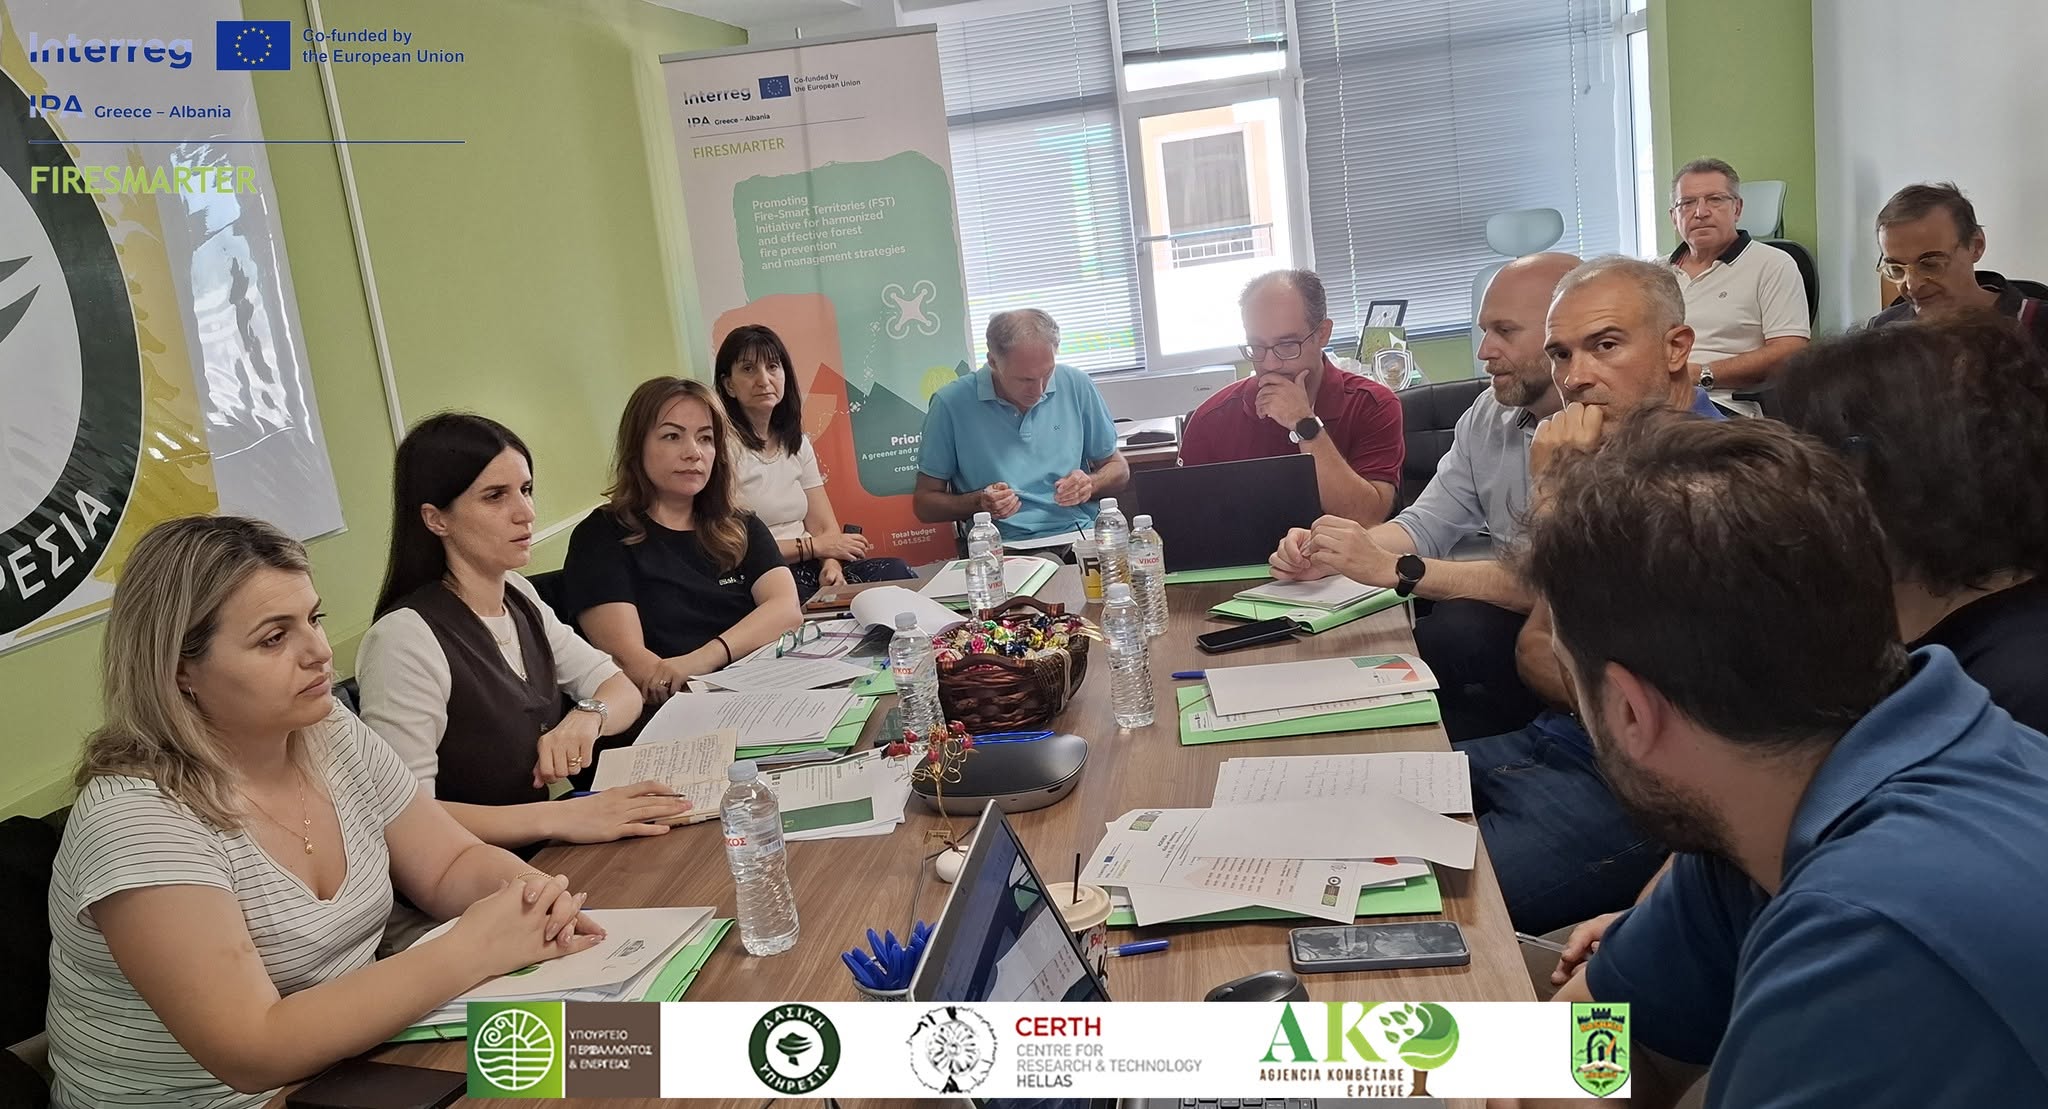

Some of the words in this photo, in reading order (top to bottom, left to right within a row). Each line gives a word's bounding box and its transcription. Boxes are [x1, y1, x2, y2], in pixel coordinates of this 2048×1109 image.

[794, 74, 828, 84] Co-funded
[829, 73, 839, 81] by
[795, 85, 806, 93] the
[807, 83, 840, 92] European
[841, 79, 861, 87] Union
[684, 87, 752, 105] Interreg
[687, 116, 710, 128] IPA
[714, 118, 739, 126] Greece
[745, 113, 771, 122] Albania
[693, 137, 785, 159] FIRESMARTER
[752, 195, 808, 210] Promoting
[754, 207, 810, 222] Fire-Smart
[812, 200, 866, 215] Territories
[868, 196, 896, 210] (FST)
[756, 221, 801, 234] Initiative
[803, 218, 819, 229] for
[822, 210, 884, 226] harmonized
[758, 235, 778, 246] and
[780, 229, 828, 244] effective
[830, 225, 863, 238] forest
[759, 247, 778, 259] fire
[780, 241, 837, 258] prevention
[761, 259, 782, 271] and
[784, 251, 852, 266] management
[854, 244, 906, 260] strategies
[891, 431, 923, 446] Priori
[868, 450, 897, 461] greener
[898, 447, 912, 455] and
[891, 530, 910, 539] Total
[911, 528, 937, 537] budget
[0, 489, 111, 600] ΕΣΙΑ
